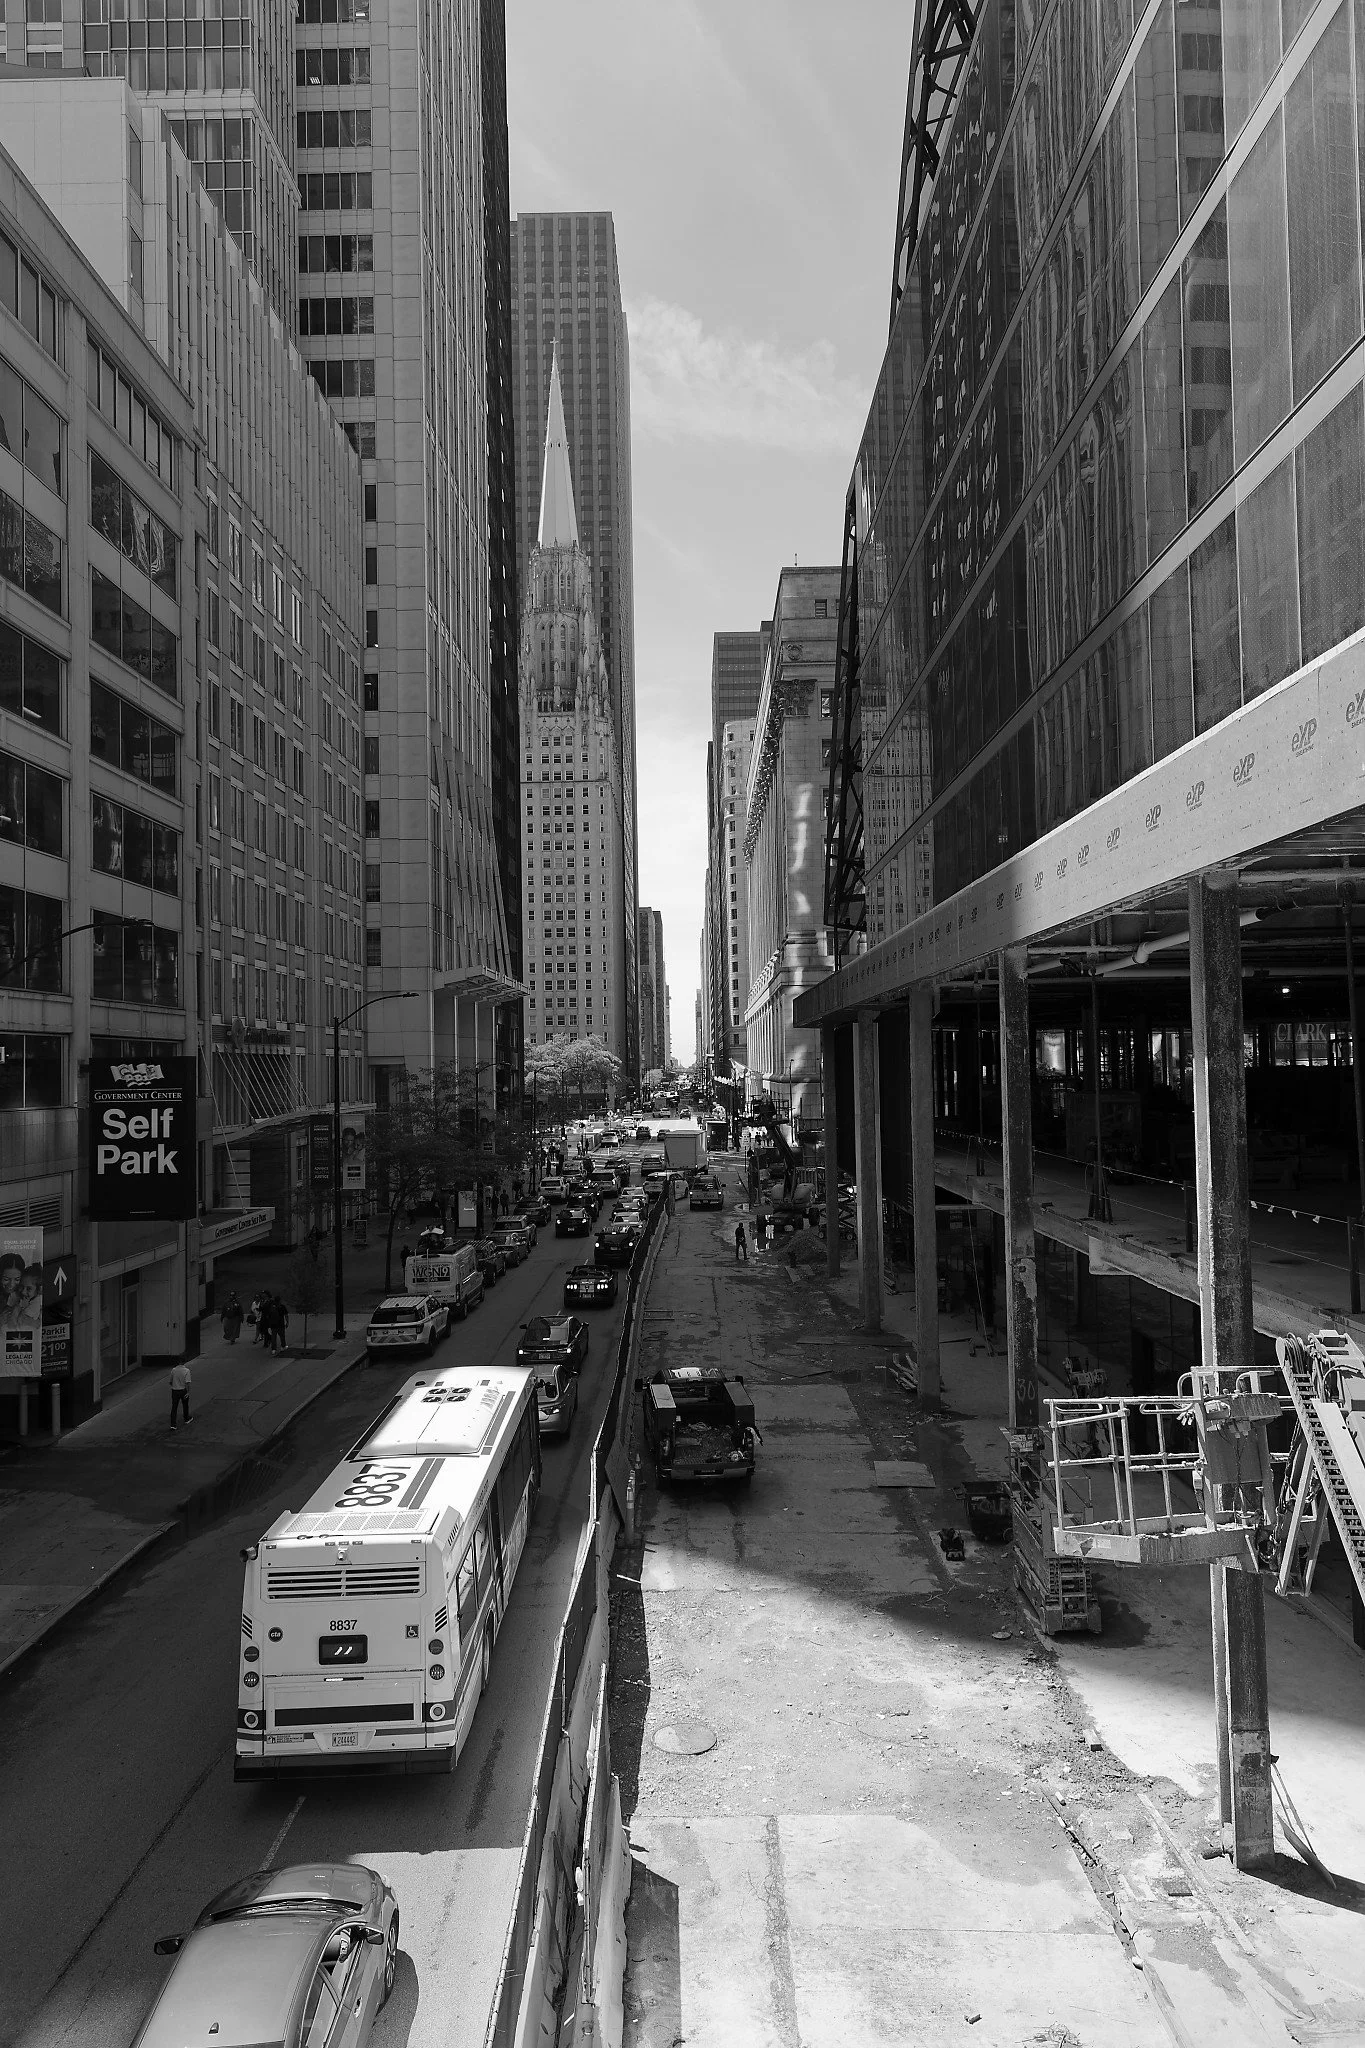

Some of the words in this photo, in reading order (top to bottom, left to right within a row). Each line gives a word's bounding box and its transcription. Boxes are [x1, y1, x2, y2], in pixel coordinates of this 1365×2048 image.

[1292, 717, 1317, 752] eXP
[1233, 752, 1255, 782] eXP
[1186, 780, 1205, 807] eXP
[1145, 804, 1162, 828] eXP
[1277, 1023, 1326, 1041] CLARK
[94, 1091, 149, 1101] GOVERNMENT
[150, 1090, 182, 1099] CENTER
[102, 1107, 174, 1140] Self
[97, 1143, 179, 1175] Park
[335, 1463, 411, 1508] 8837
[329, 1619, 358, 1631] 8837
